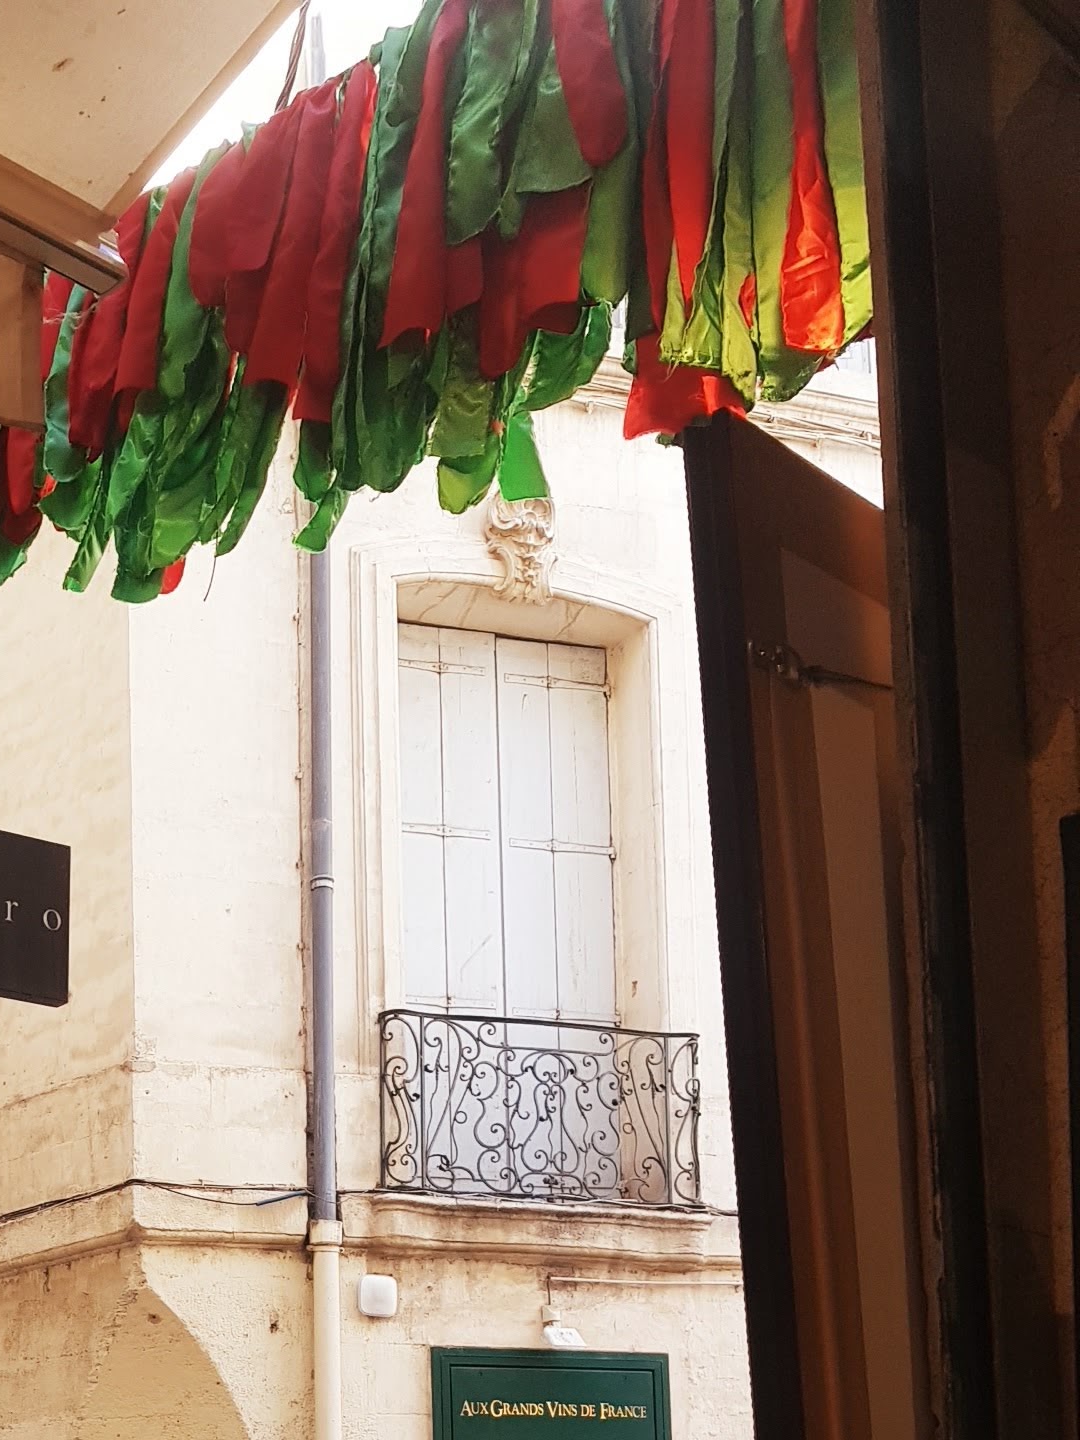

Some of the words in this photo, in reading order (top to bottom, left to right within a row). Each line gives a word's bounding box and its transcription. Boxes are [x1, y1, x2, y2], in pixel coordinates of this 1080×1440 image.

[490, 1400, 545, 1418] GRANDS
[546, 1400, 578, 1418] VINS
[600, 1403, 647, 1420] FRANCE
